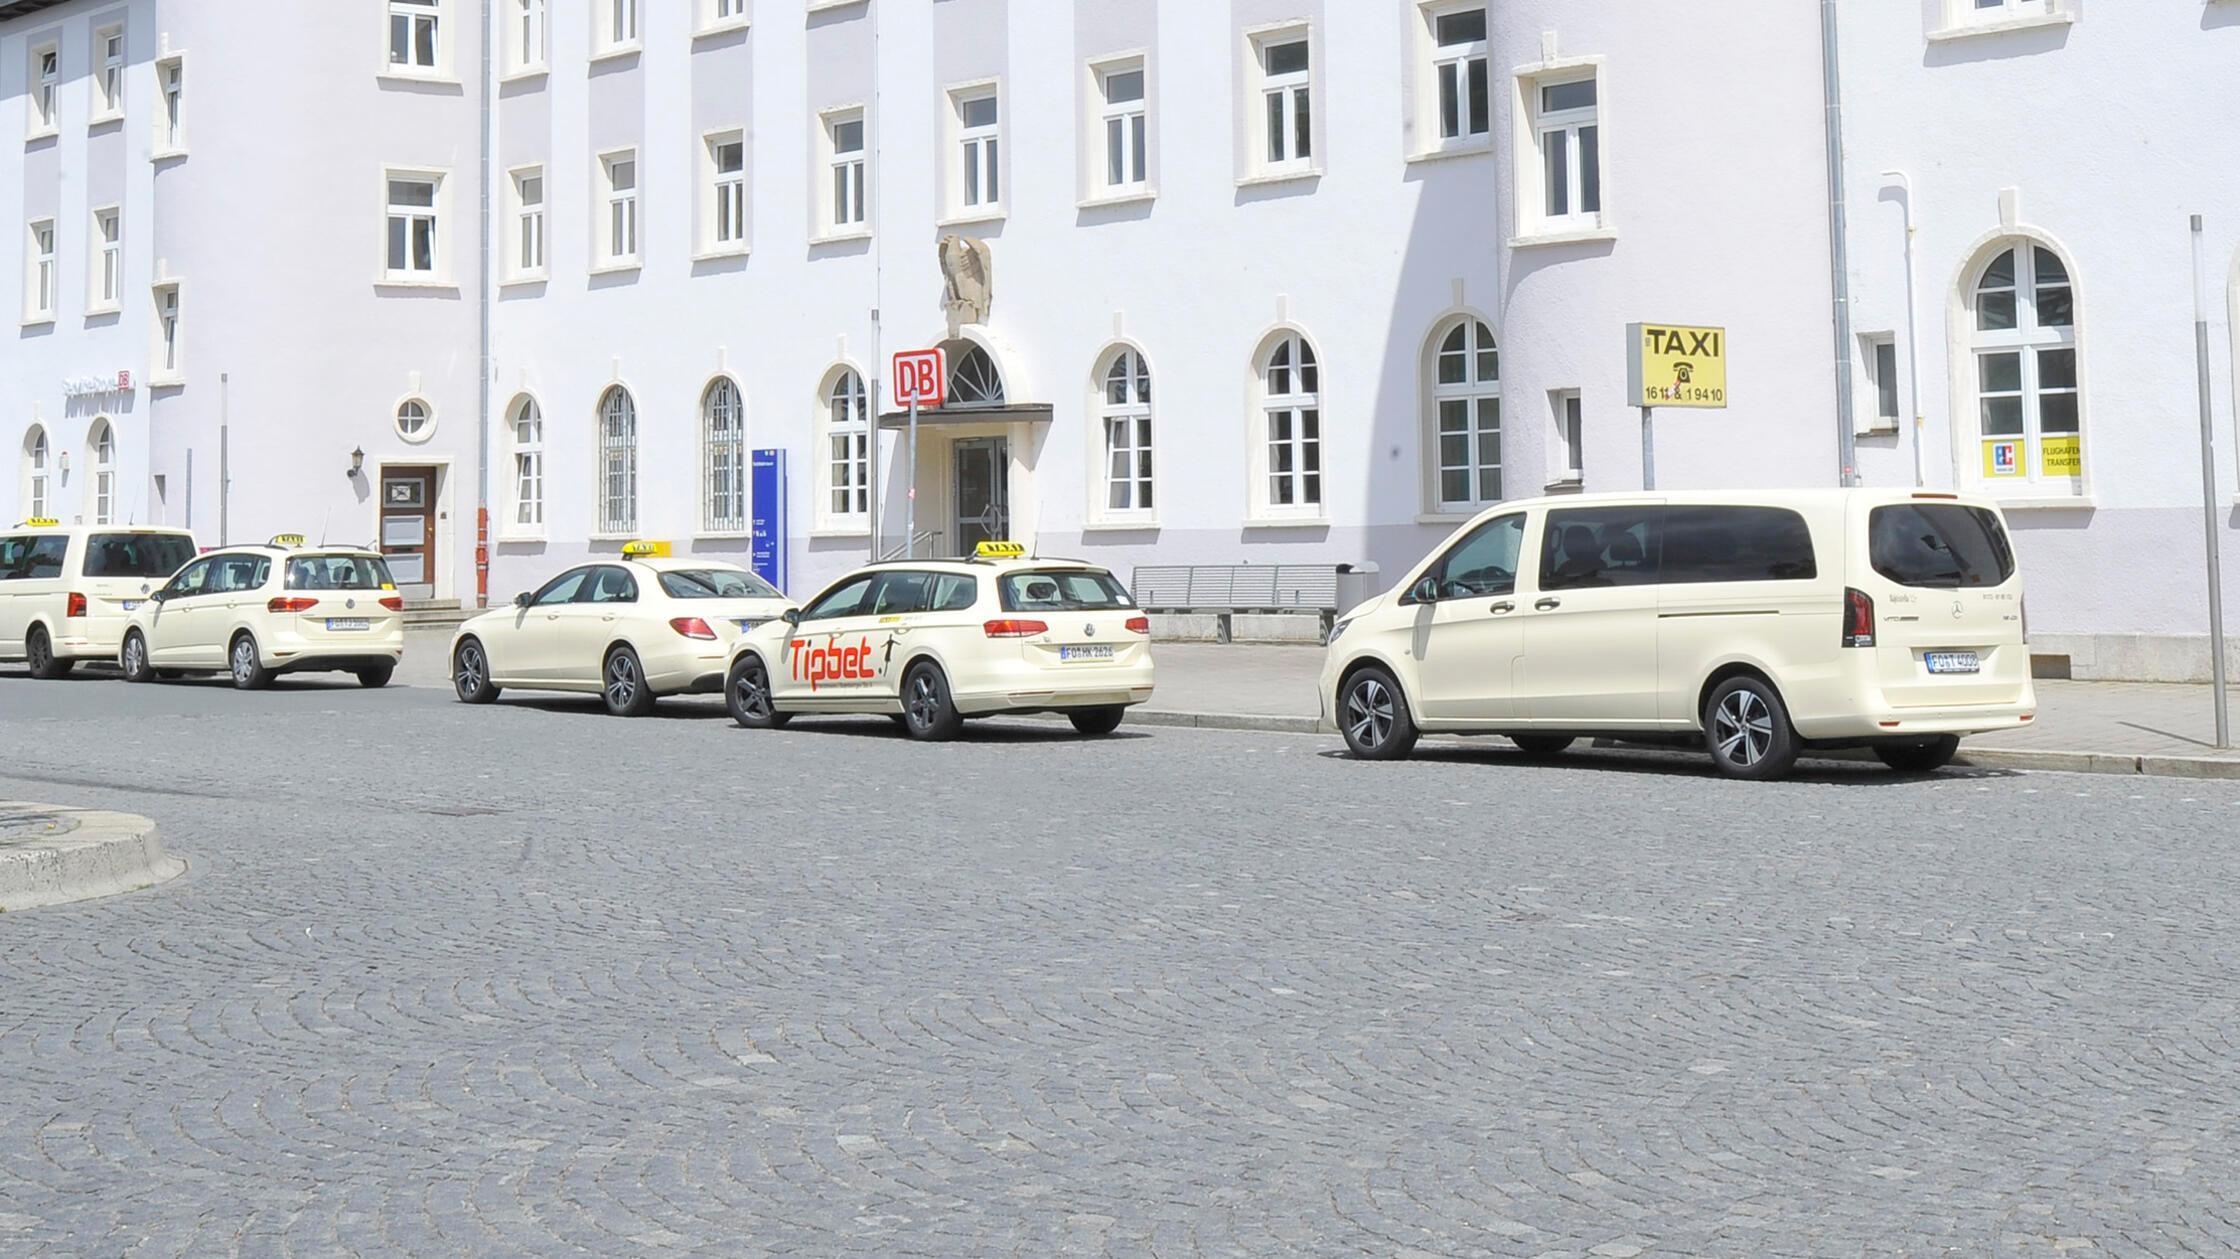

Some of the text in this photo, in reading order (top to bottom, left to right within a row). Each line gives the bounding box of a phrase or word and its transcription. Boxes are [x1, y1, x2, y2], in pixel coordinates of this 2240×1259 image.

[1647, 329, 1719, 357] TAXI
[899, 359, 935, 397] DB
[790, 636, 875, 692] Tipbet
